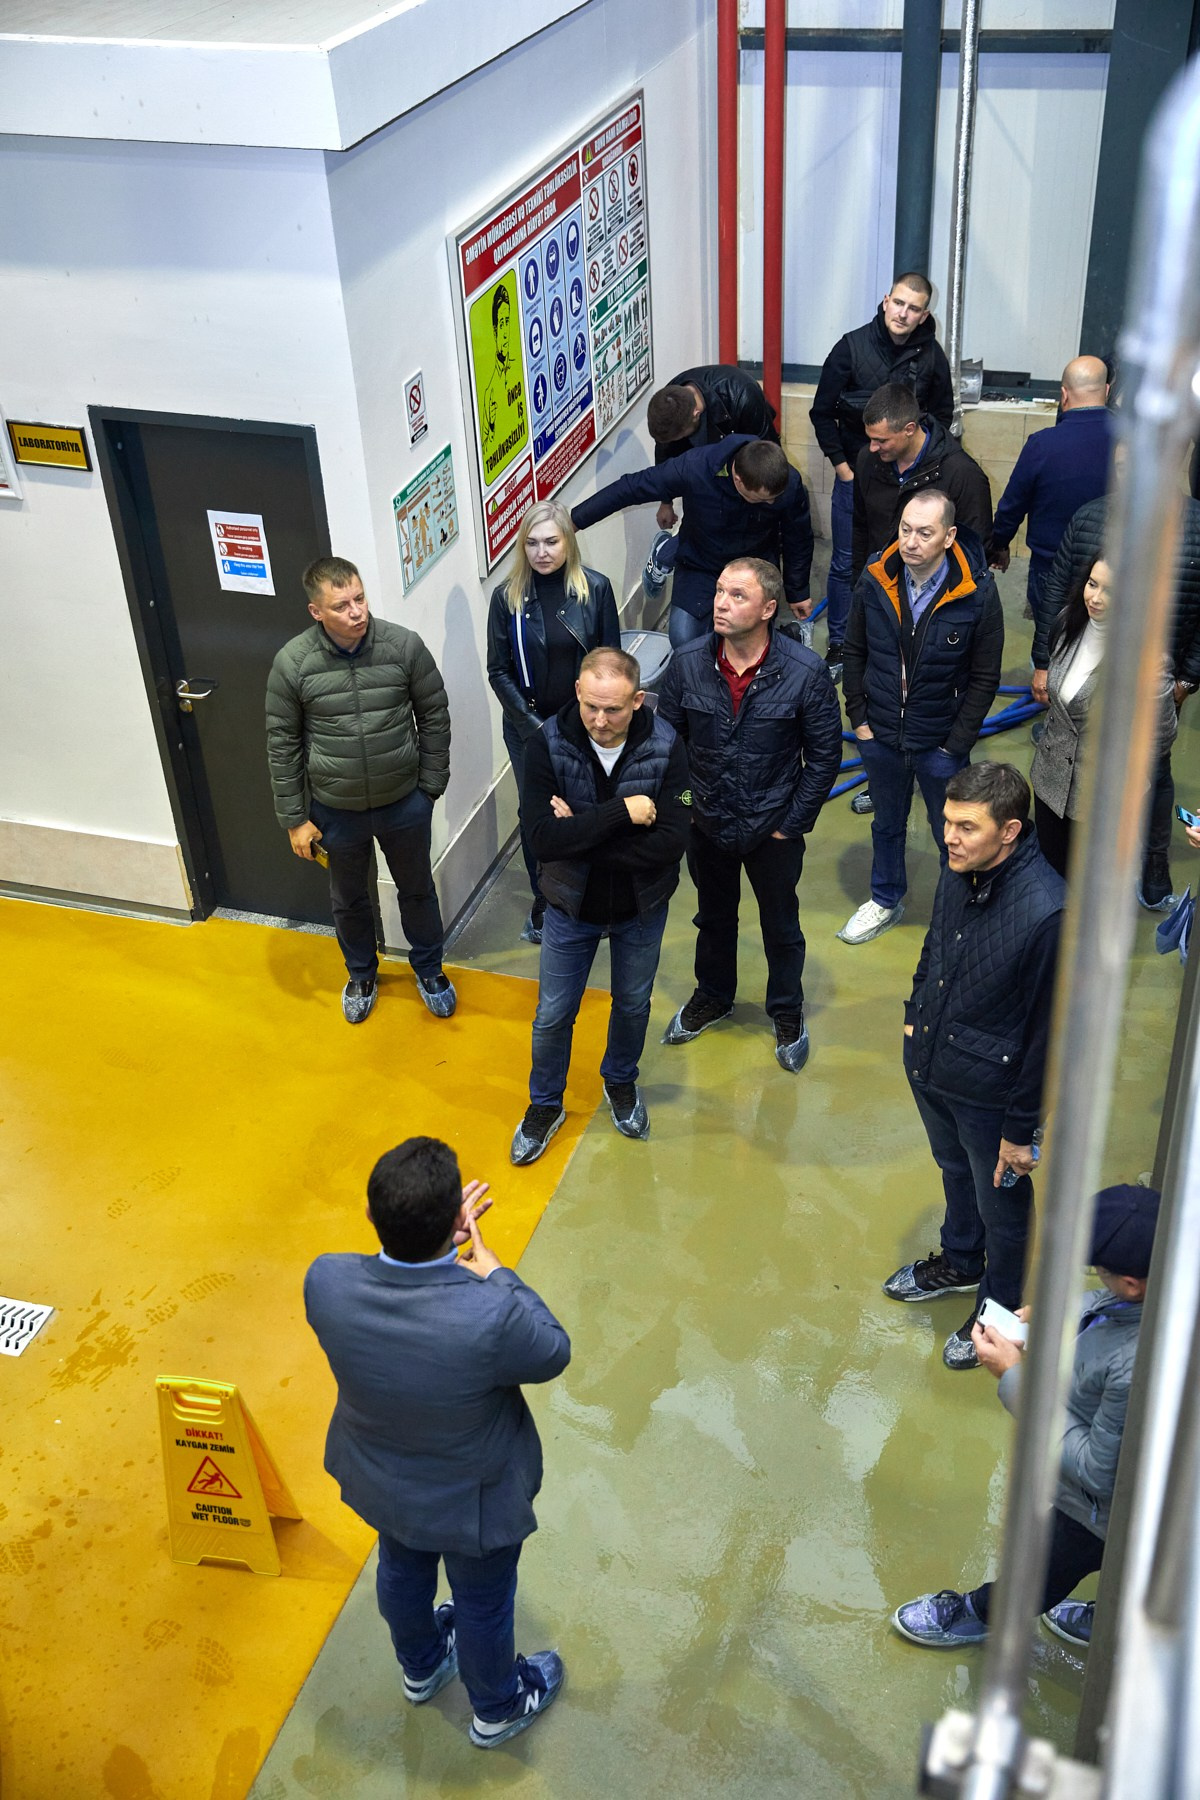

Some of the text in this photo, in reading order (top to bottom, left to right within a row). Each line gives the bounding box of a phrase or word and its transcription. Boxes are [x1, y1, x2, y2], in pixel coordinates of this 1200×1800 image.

[517, 203, 525, 222] VƏ
[507, 381, 522, 407] ÖNCƏ
[18, 436, 81, 453] LABORATORİYA
[486, 419, 526, 474] TƏHLÜKƏSİZLİYİ
[185, 1427, 224, 1441] DİKKAT!
[176, 1438, 235, 1454] KAYGAN ZEMİN
[196, 1502, 232, 1516] CAUTION
[192, 1512, 210, 1522] WET
[212, 1514, 240, 1526] FLOOR
[524, 1688, 540, 1715] N
